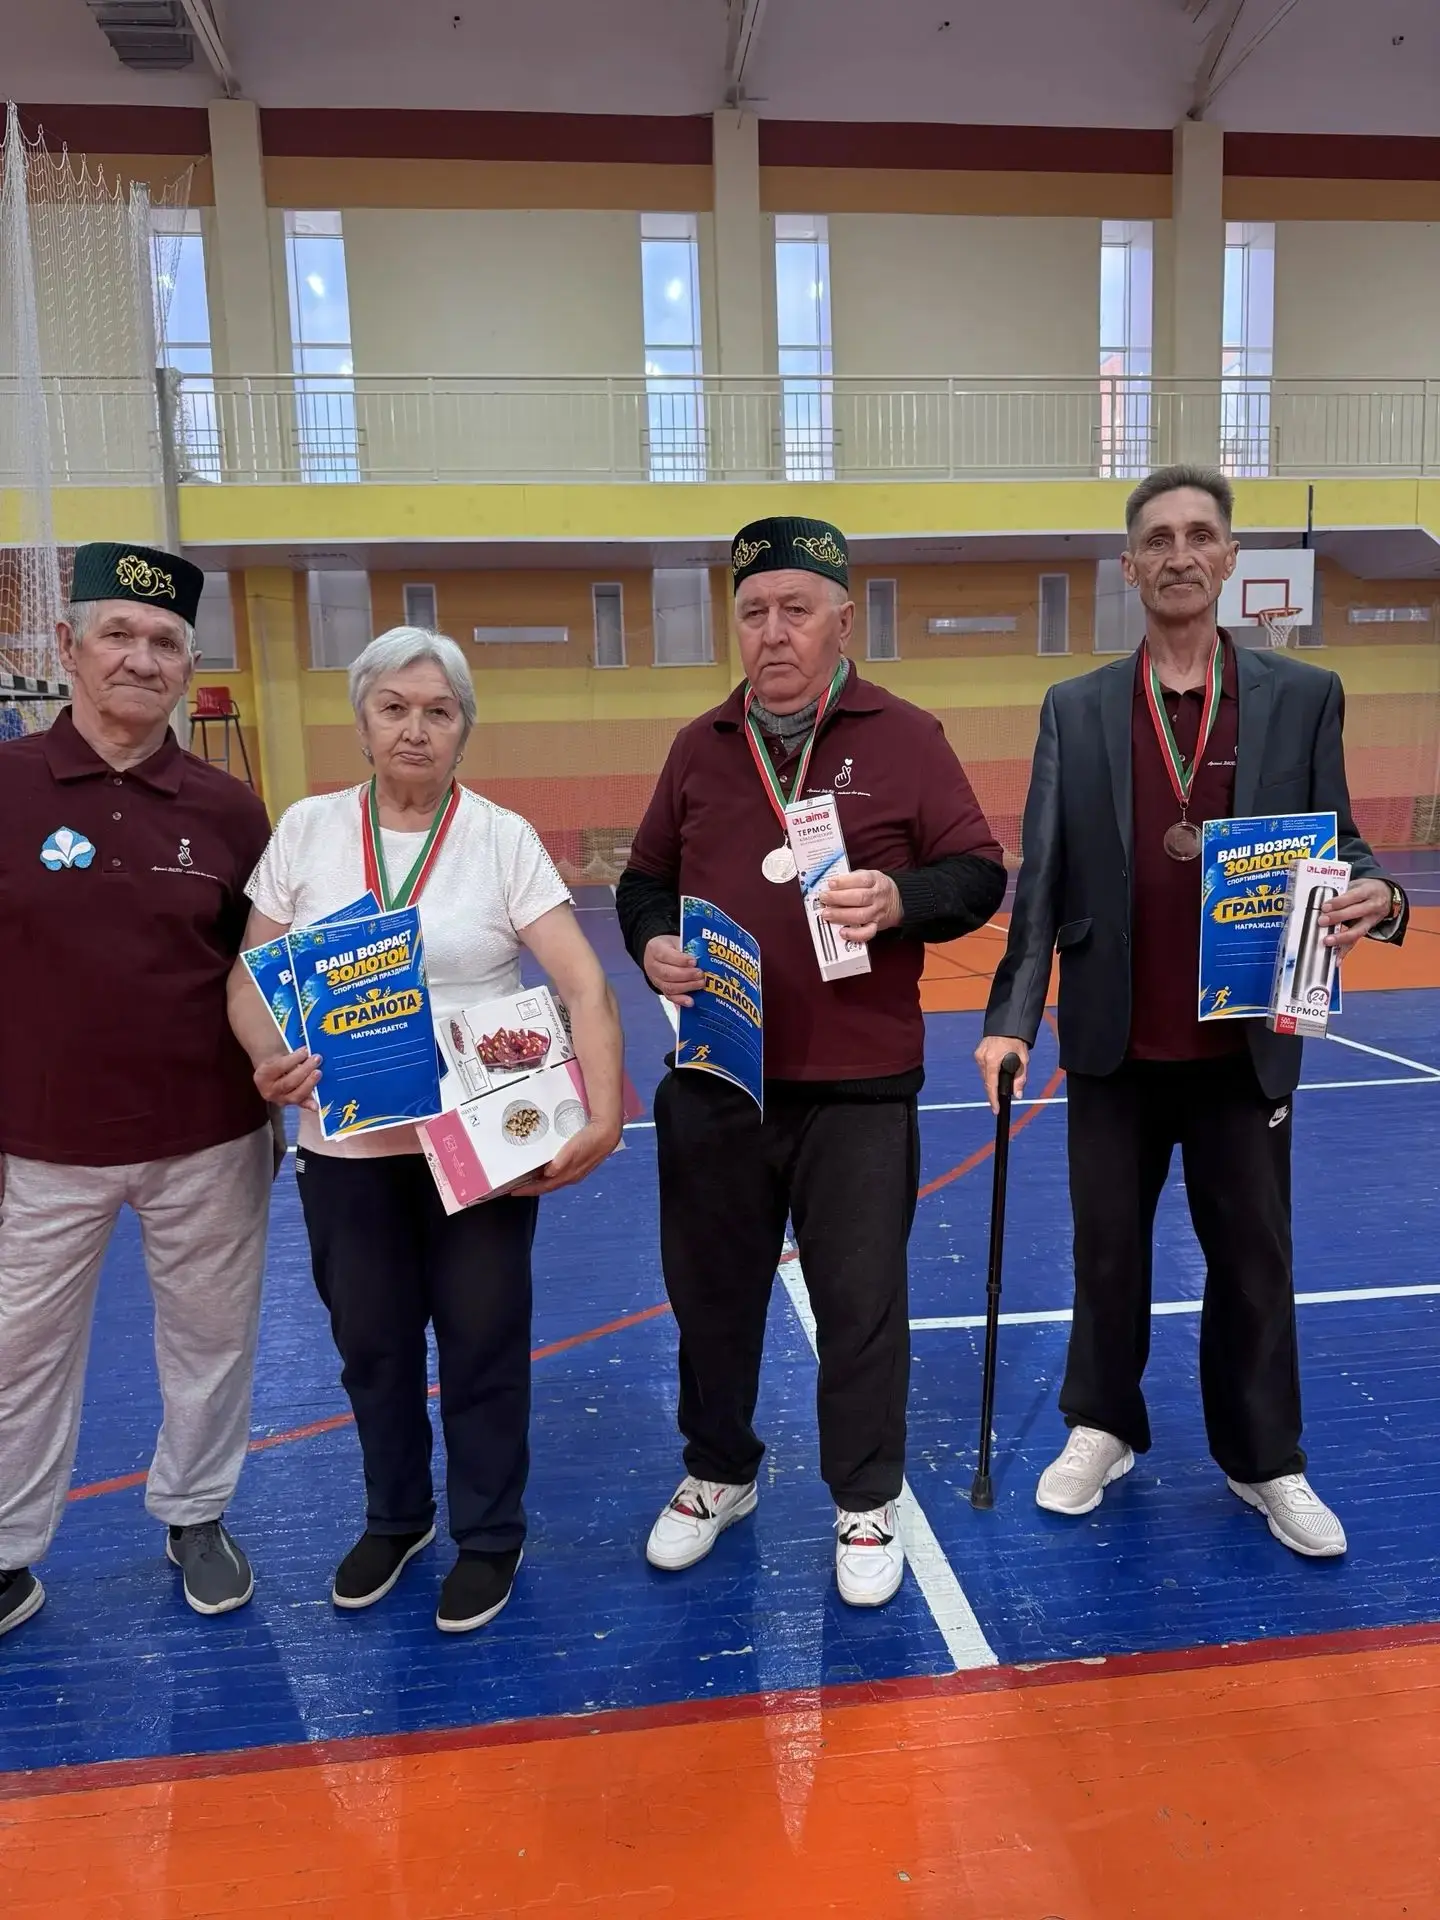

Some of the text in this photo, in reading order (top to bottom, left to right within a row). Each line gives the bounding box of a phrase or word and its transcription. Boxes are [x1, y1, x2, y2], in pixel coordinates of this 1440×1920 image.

[800, 811, 830, 824] Laima
[797, 823, 832, 836] ТЕРМОС
[1217, 834, 1317, 863] ВАШ ВОЗРАСТ
[1227, 871, 1271, 886] СПОРТИВНЫЙ
[1314, 866, 1346, 876] Laima
[1222, 897, 1285, 919] ГРАМО
[702, 928, 728, 947] ВАШ
[315, 951, 354, 974] ВАШ
[356, 929, 411, 960] ВОЗРАСТ
[708, 941, 758, 981] ЗОЛОТОЙ
[327, 943, 410, 986] ЗОЛОТОЙ
[333, 964, 411, 995] СПОРТИВНЫЙ ПРАЗДНИК
[705, 976, 759, 1022] ГРАМОТА
[1312, 992, 1325, 1001] 24
[333, 993, 417, 1030] ГРАМОТА
[1285, 1005, 1326, 1018] ТЕРМОС
[351, 1022, 408, 1039] НАГРАЖДАЕТСЯ
